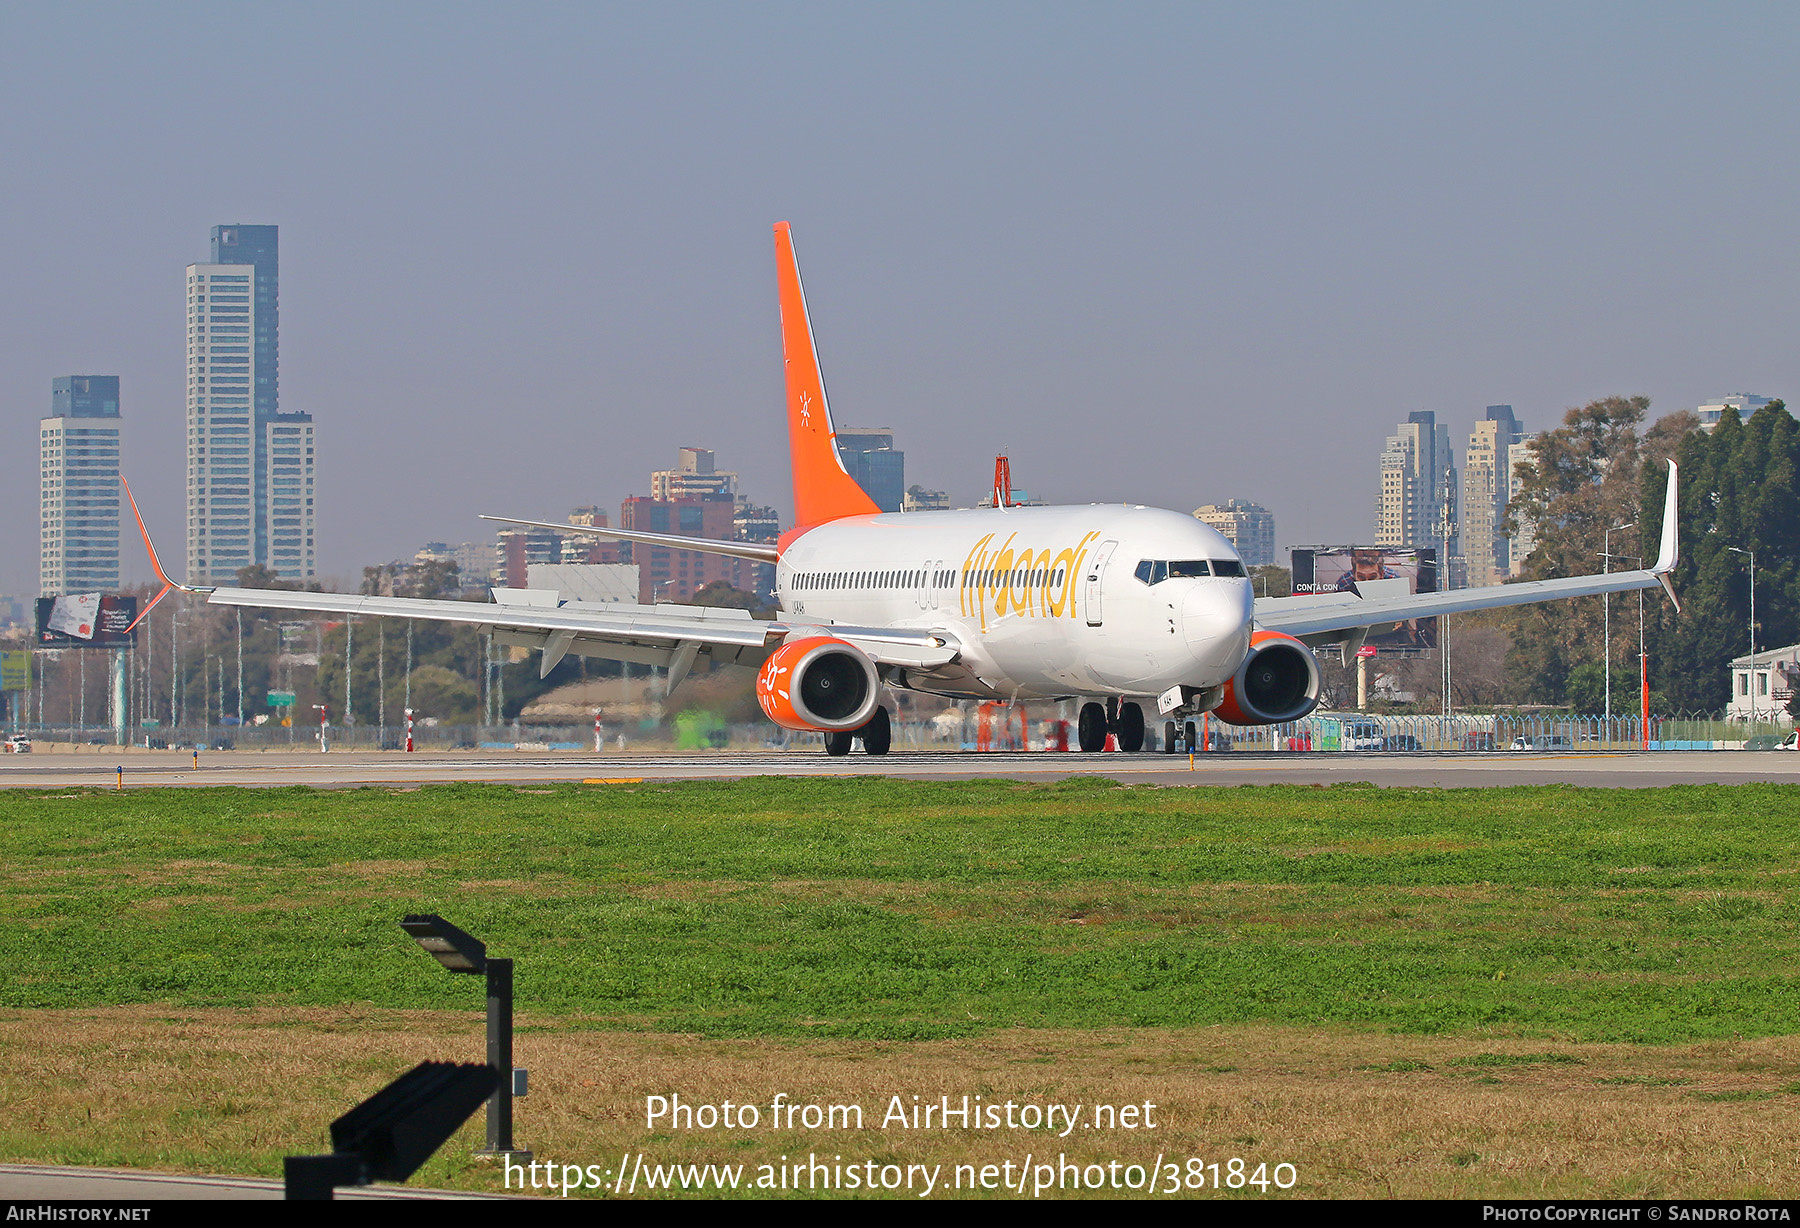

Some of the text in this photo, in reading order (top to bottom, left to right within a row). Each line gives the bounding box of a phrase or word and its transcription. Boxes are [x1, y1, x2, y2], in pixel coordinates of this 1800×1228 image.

[960, 531, 1101, 634] flybondi
[1296, 581, 1339, 592] CONTÁ CON
